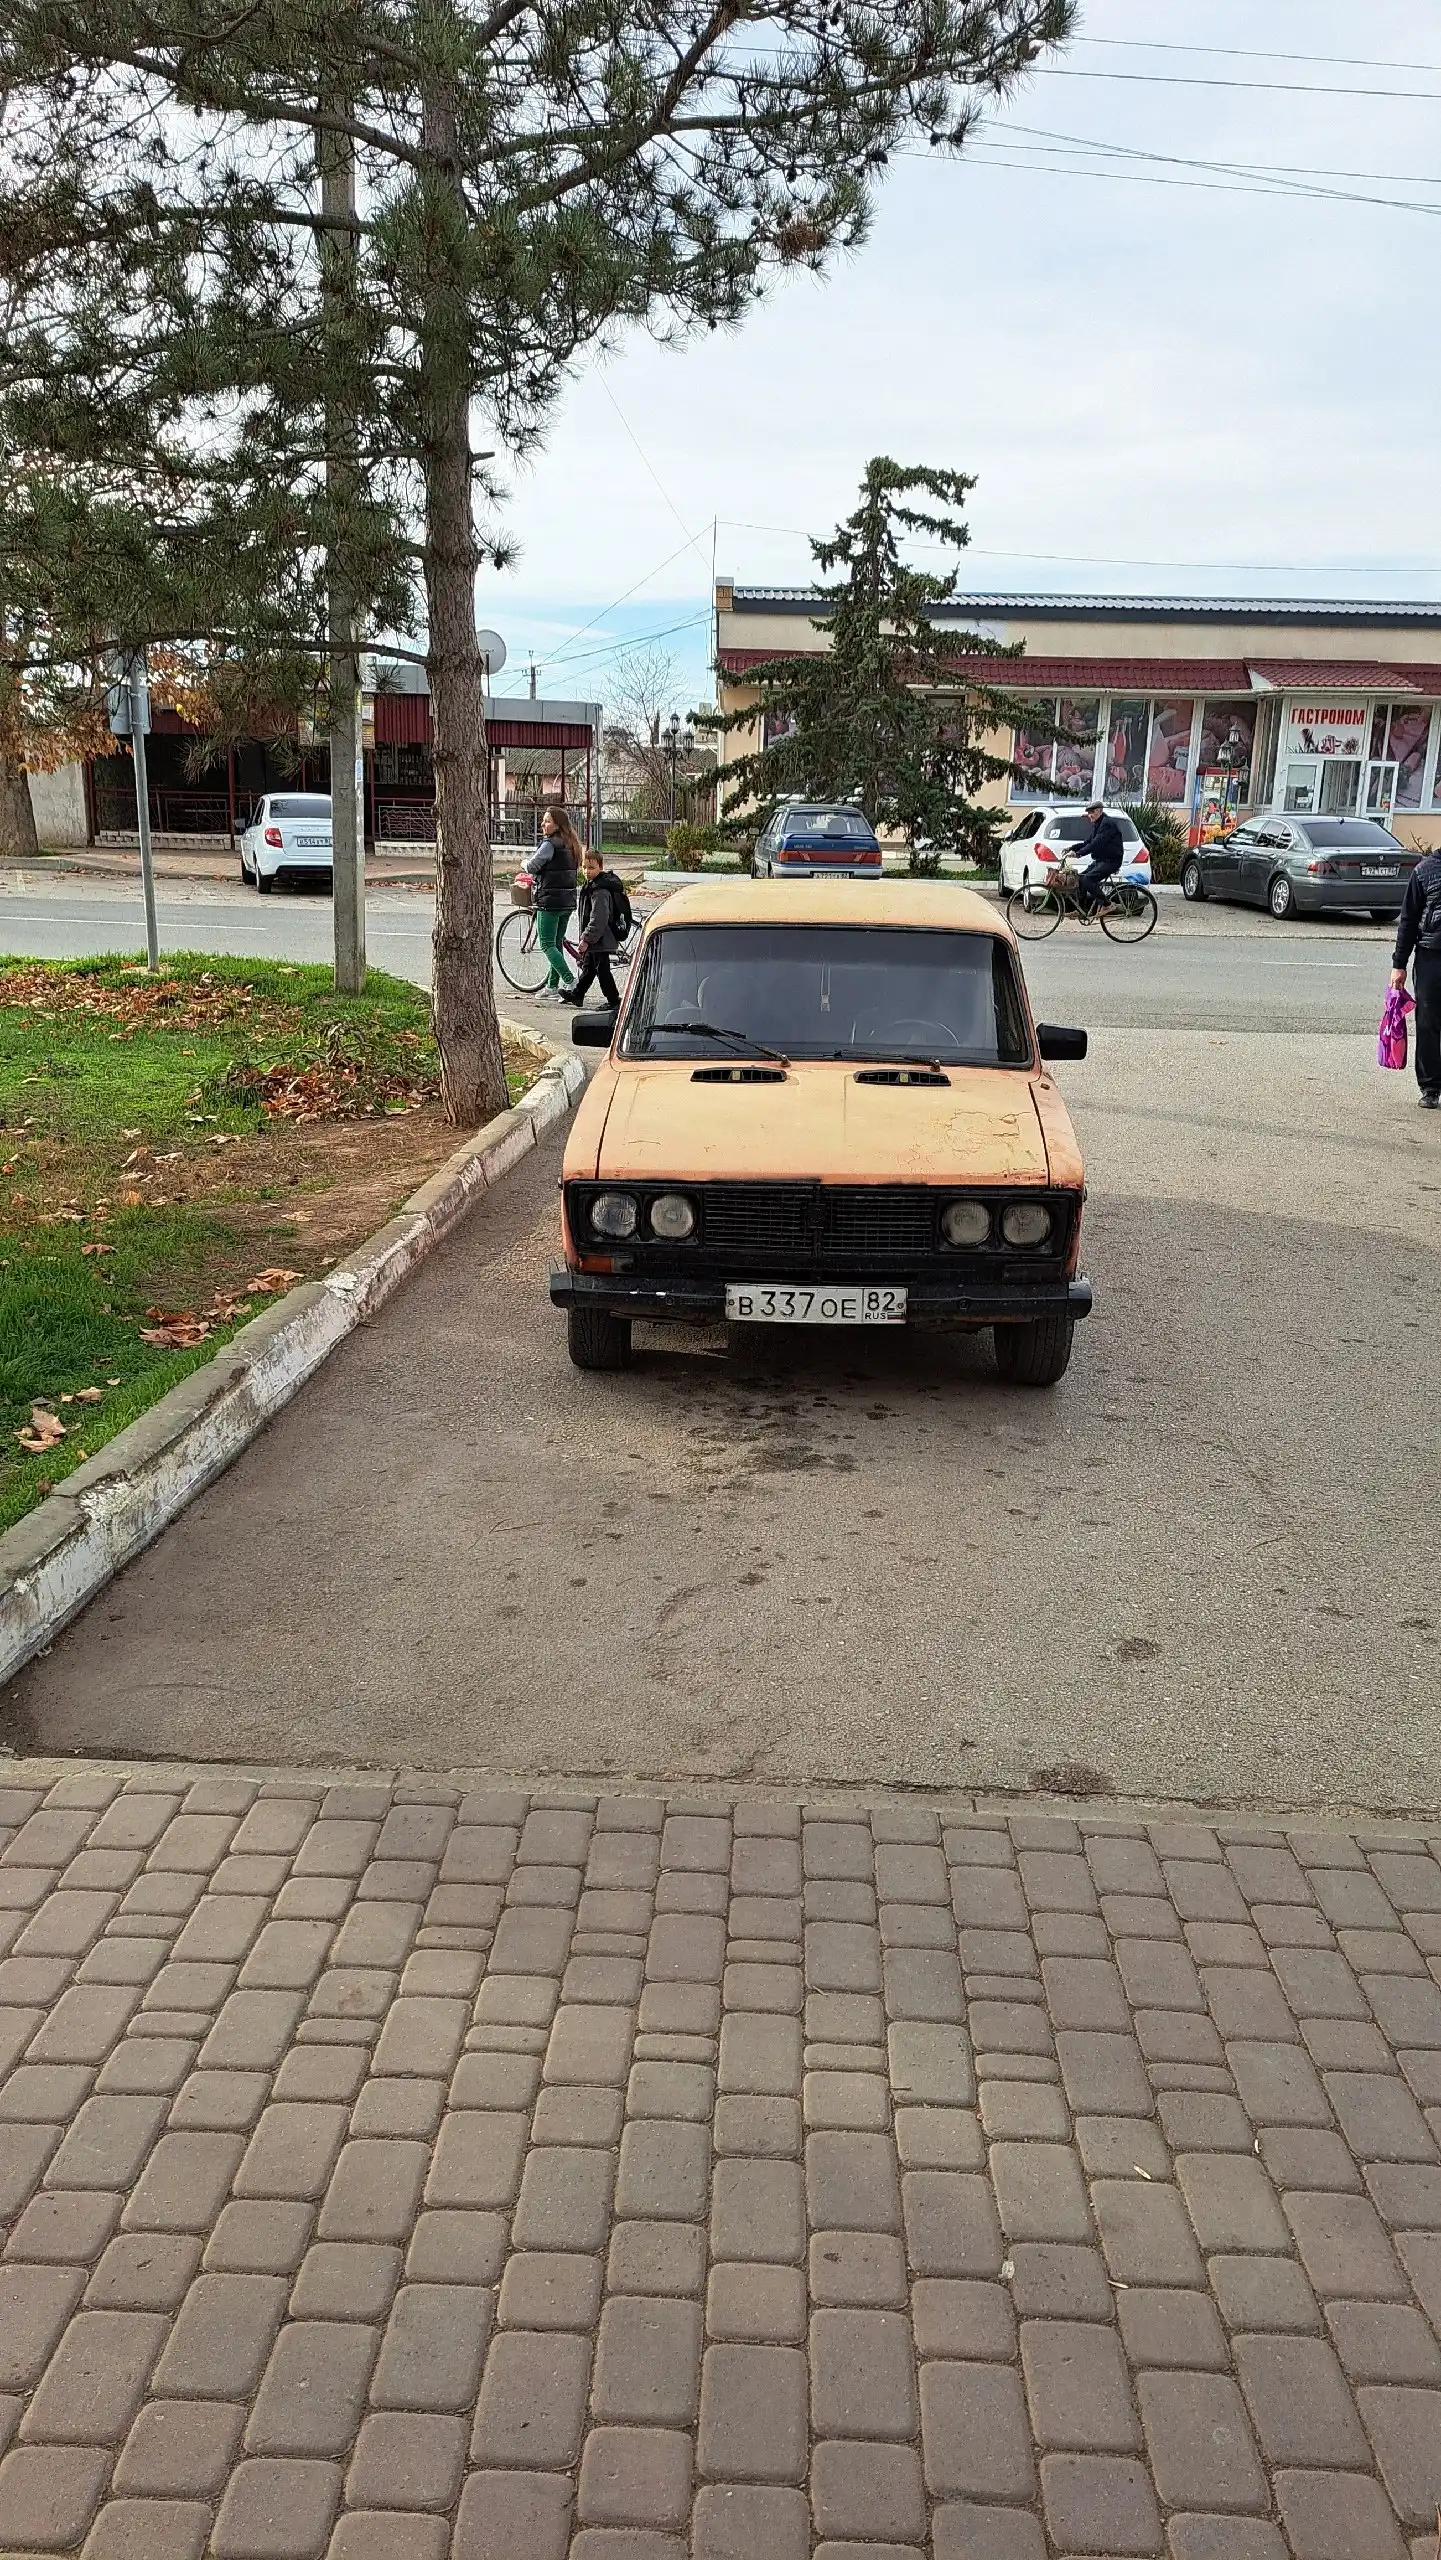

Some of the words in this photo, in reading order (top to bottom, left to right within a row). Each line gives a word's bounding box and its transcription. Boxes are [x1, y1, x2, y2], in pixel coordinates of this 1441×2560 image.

[1290, 707, 1366, 726] ГАСТРОНОМ
[866, 1291, 896, 1312] 82
[864, 1311, 887, 1321] RUS
